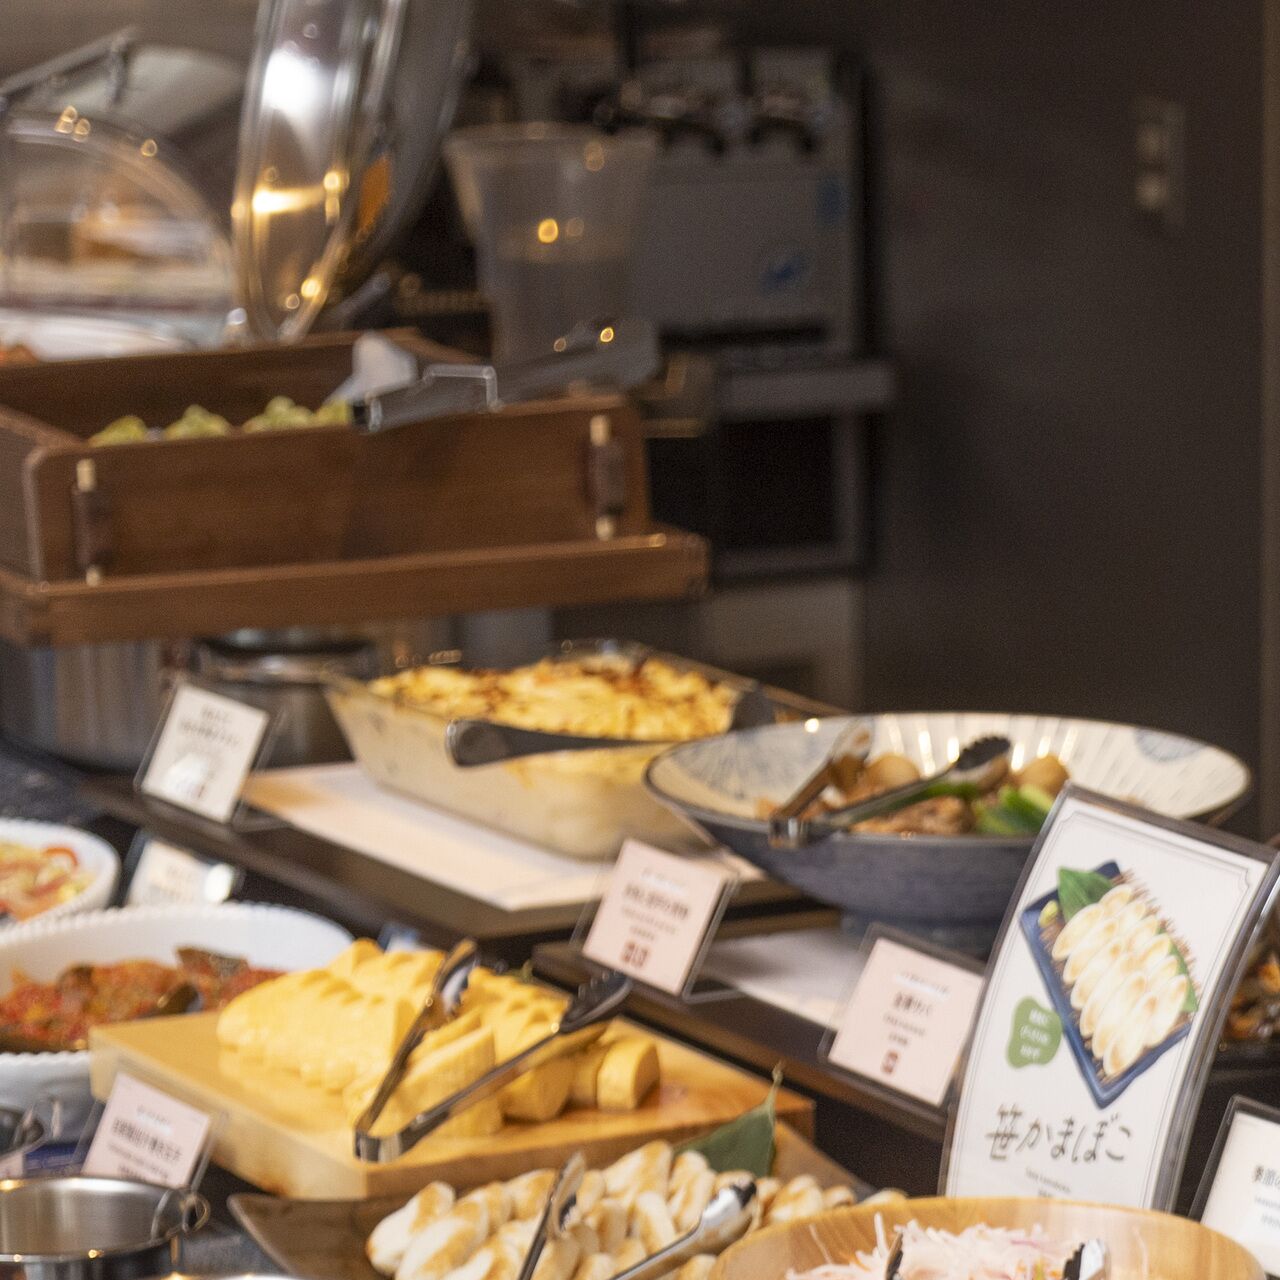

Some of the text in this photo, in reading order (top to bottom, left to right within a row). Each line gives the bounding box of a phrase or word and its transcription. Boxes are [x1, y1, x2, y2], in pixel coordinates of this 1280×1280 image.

[985, 1103, 1132, 1163] 笹かまぼこ
